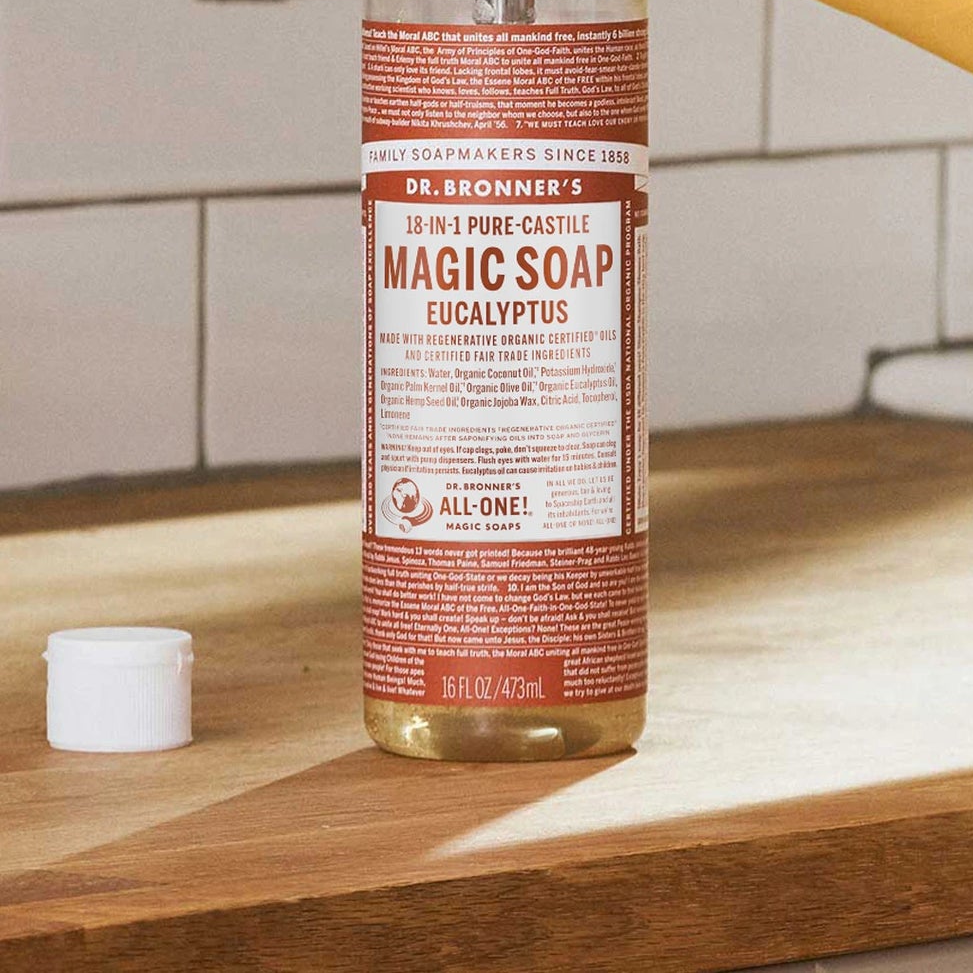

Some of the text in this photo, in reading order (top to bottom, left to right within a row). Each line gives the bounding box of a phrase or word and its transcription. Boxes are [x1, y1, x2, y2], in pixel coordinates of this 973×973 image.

[399, 30, 611, 42] Moral ABC that unites all mankind free, instantly
[437, 47, 455, 56] Army
[457, 47, 465, 55] of
[467, 47, 505, 56] Principles
[507, 47, 516, 55] of
[440, 56, 458, 64] truth
[460, 57, 481, 65] Moral
[483, 57, 500, 65] ABC
[512, 57, 531, 65] unite
[544, 56, 574, 64] mankind
[576, 55, 589, 63] free
[454, 67, 511, 76] Lacking frontal
[513, 77, 535, 85] Moral
[547, 99, 556, 107] he
[558, 99, 587, 107] becomes
[468, 110, 500, 119] neighbor
[579, 109, 592, 117] also
[542, 120, 562, 128] MUST
[370, 148, 630, 164] FAMILY SOAPMAKERS SINCE 1858
[406, 178, 582, 197] DR. BRONNER'S
[406, 215, 590, 235] 18-IN-1 PURE-CASTILE
[384, 243, 614, 291] MAGIC SOAP
[427, 300, 568, 325] EUCALYPTUS
[380, 333, 400, 344] MADE
[403, 333, 423, 345] WITH
[426, 334, 497, 346] REGENERATIVE
[501, 333, 545, 346] ORGANIC
[600, 330, 616, 341] OILS
[405, 347, 591, 362] AND CERTIFIED FAIR TRADE INGREDIENTS
[455, 368, 486, 380] Organic
[487, 368, 521, 378] Coconut
[541, 365, 580, 377] Potassium
[381, 380, 404, 392] Organic
[405, 381, 422, 391] Palm
[466, 382, 498, 395] Organic
[500, 383, 520, 393] Olive
[540, 380, 569, 393] Organic
[381, 393, 404, 406] Organic
[426, 396, 444, 406] Seed
[460, 397, 492, 409] Organic
[493, 397, 518, 409] Jojoba
[541, 395, 561, 406] Citric
[463, 445, 531, 455] cap don't
[478, 455, 550, 465] Flush eyes with water
[462, 467, 496, 476] Eucalyptus
[464, 482, 520, 490] BRONNER'S
[440, 497, 527, 516] ALL-ONE!
[446, 523, 520, 531] MAGIC SOAPS
[466, 549, 477, 558] got
[480, 549, 509, 558] printed!
[512, 549, 543, 557] Because
[544, 548, 556, 556] the
[558, 547, 584, 555] brilliant
[428, 557, 592, 567] Thomas Samuel Steiner-Prag
[433, 571, 553, 581] One-God-State being
[552, 583, 566, 591] Son
[504, 594, 531, 603] change
[508, 613, 538, 623] don't be
[506, 646, 606, 657] Moral ABC uniting mankind
[442, 676, 456, 698] 16
[459, 677, 472, 699] FL
[475, 676, 492, 699] OZ
